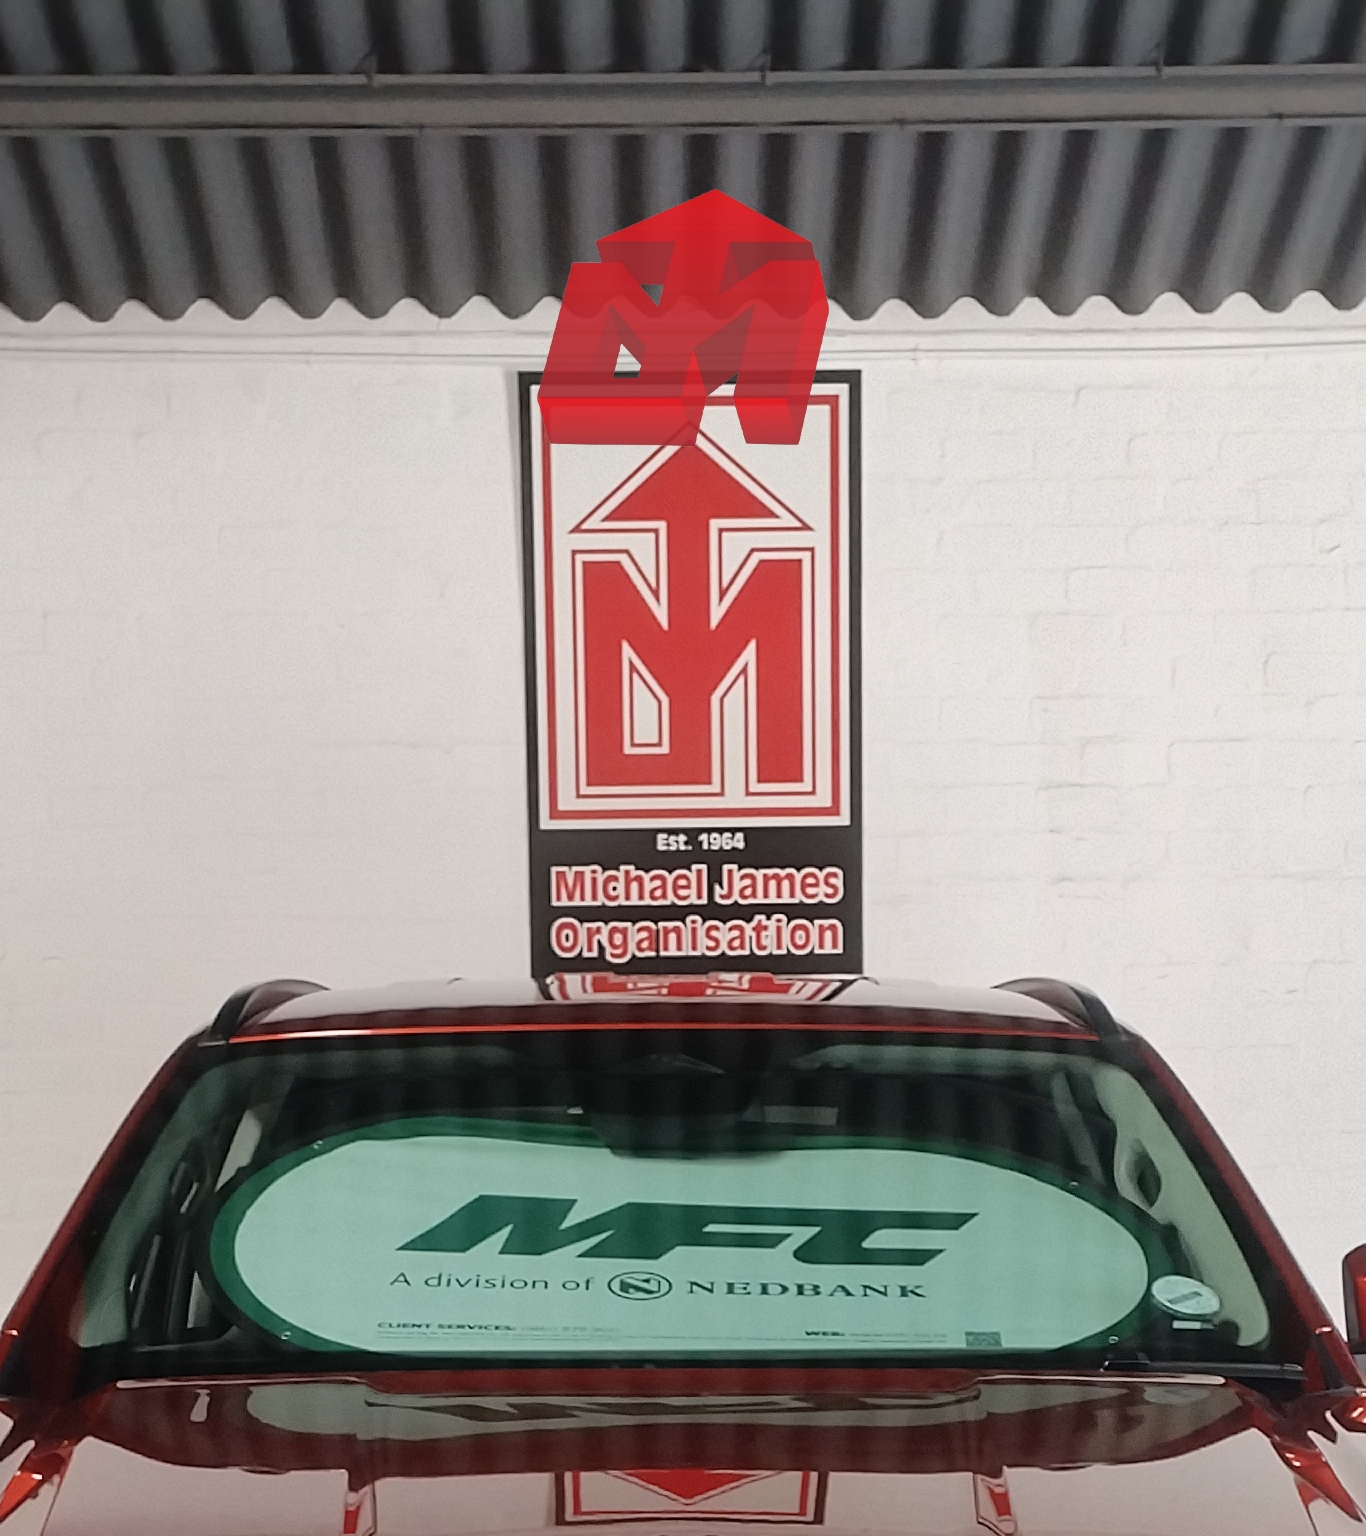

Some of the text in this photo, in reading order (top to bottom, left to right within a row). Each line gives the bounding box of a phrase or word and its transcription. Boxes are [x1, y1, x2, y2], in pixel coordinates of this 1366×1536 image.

[656, 831, 746, 851] Est. 1964
[551, 862, 844, 906] Michael James
[550, 913, 842, 962] Organisation
[396, 1194, 979, 1266] MFC
[390, 1271, 927, 1298] A division of NEDBANK
